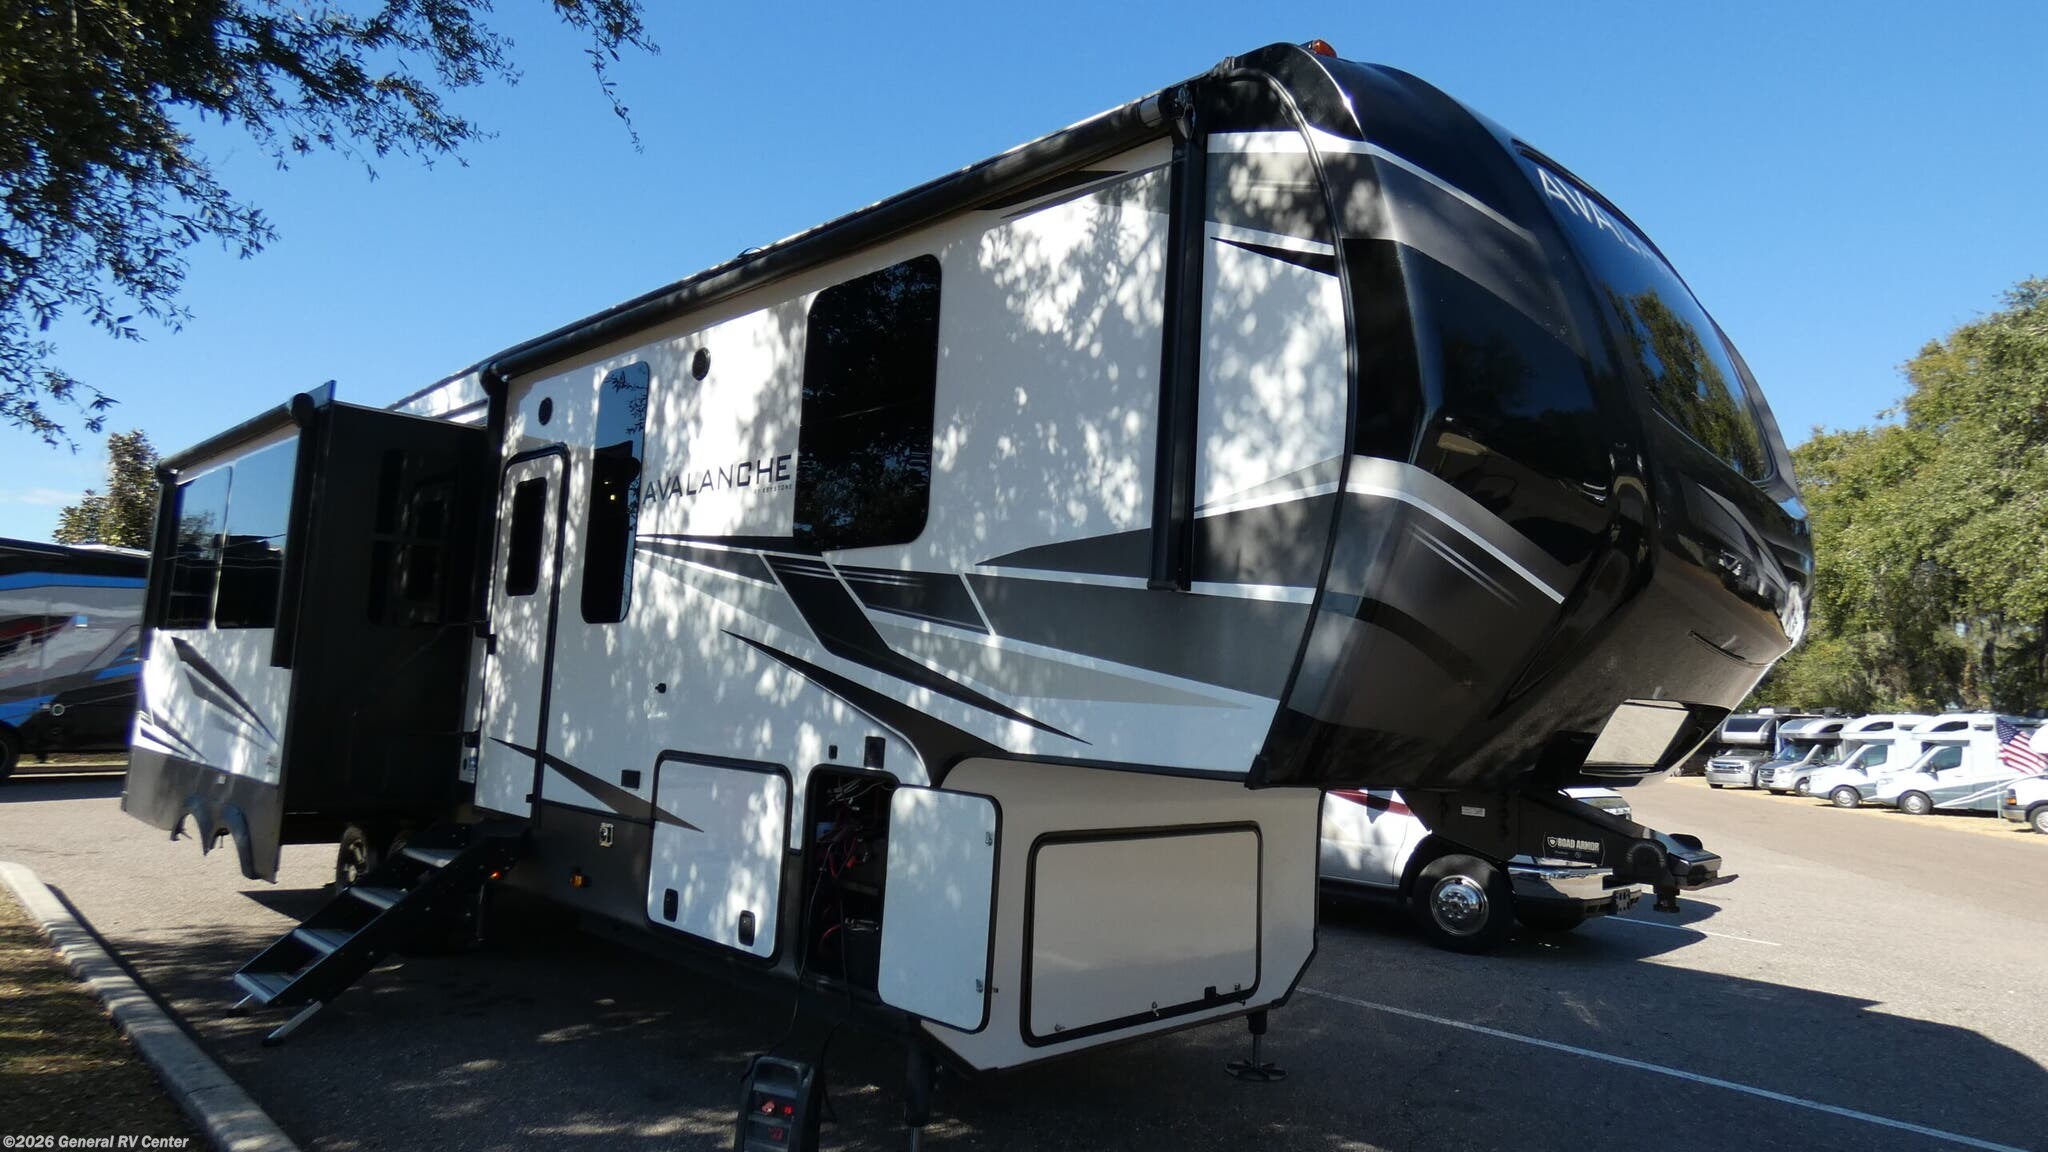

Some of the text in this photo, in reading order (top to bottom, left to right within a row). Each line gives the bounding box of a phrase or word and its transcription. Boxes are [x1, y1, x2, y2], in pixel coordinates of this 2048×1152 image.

[642, 454, 792, 505] AVALANCHE
[1557, 837, 1600, 852] ROAD ARMOR
